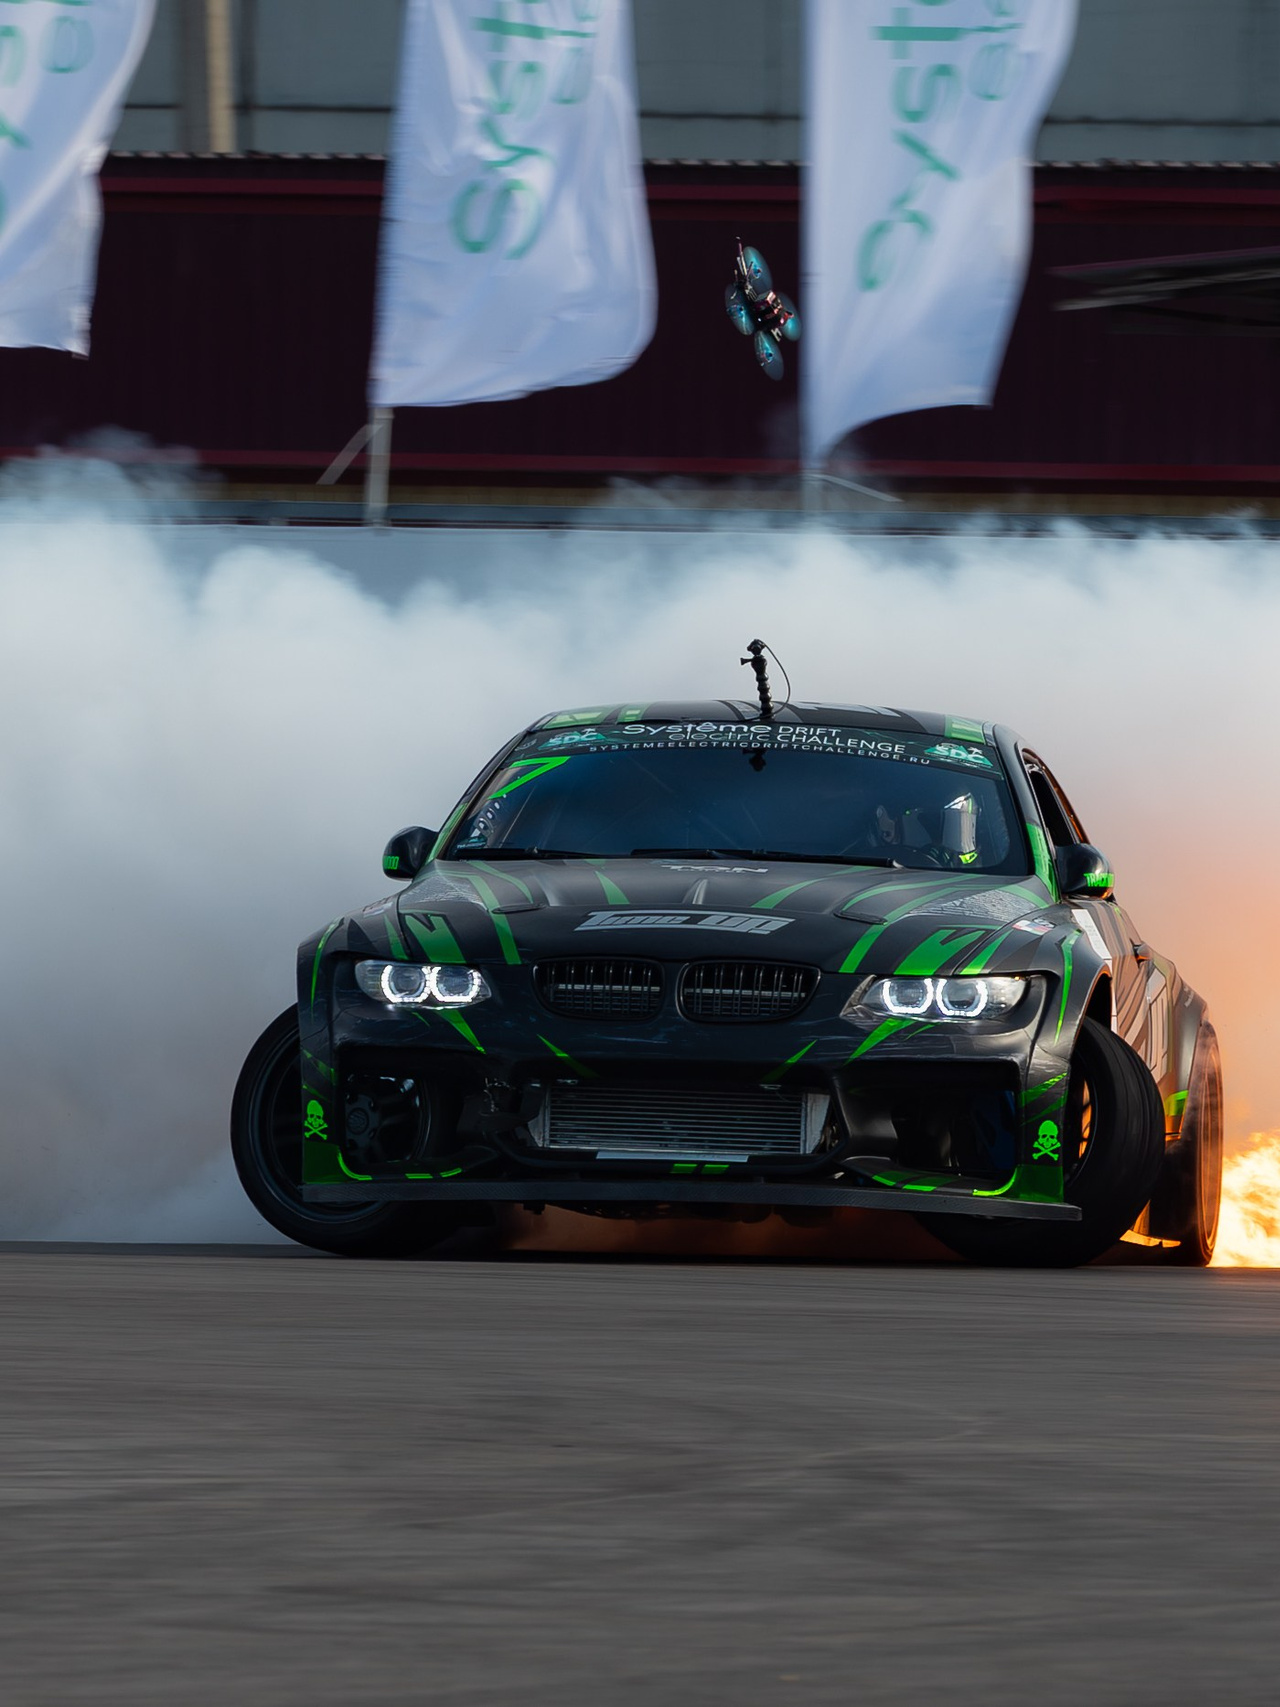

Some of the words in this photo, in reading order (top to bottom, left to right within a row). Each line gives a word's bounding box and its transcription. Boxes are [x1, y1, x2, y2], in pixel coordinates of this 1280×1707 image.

[453, 0, 548, 259] Syst
[622, 721, 772, 735] Systême
[778, 725, 842, 737] DRIFT
[668, 731, 771, 742] electric
[776, 733, 906, 754] CHALLENGE
[488, 755, 572, 799] 7
